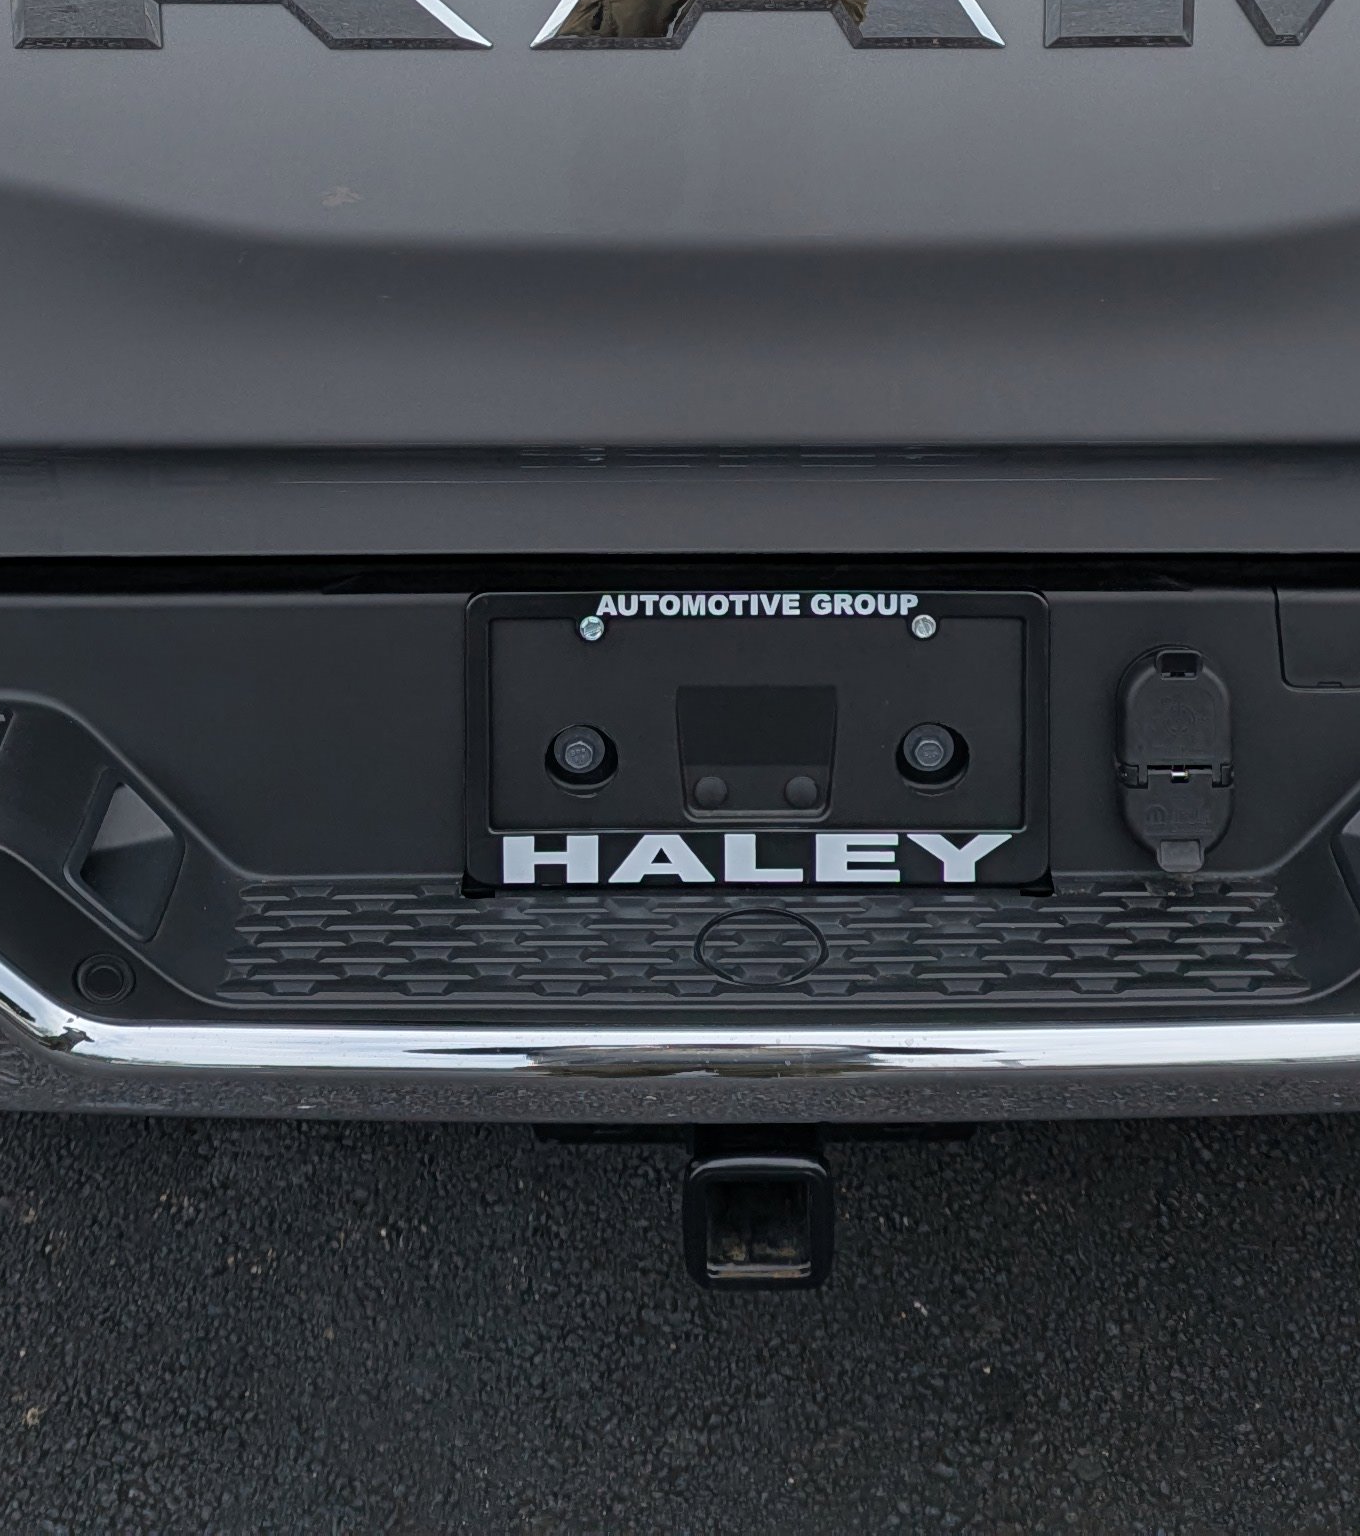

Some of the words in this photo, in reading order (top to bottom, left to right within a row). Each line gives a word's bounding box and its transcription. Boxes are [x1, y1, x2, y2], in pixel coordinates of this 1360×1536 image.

[596, 593, 801, 617] AUTOMOTIVE
[810, 593, 919, 616] GROUP
[502, 833, 1013, 884] HALEY
